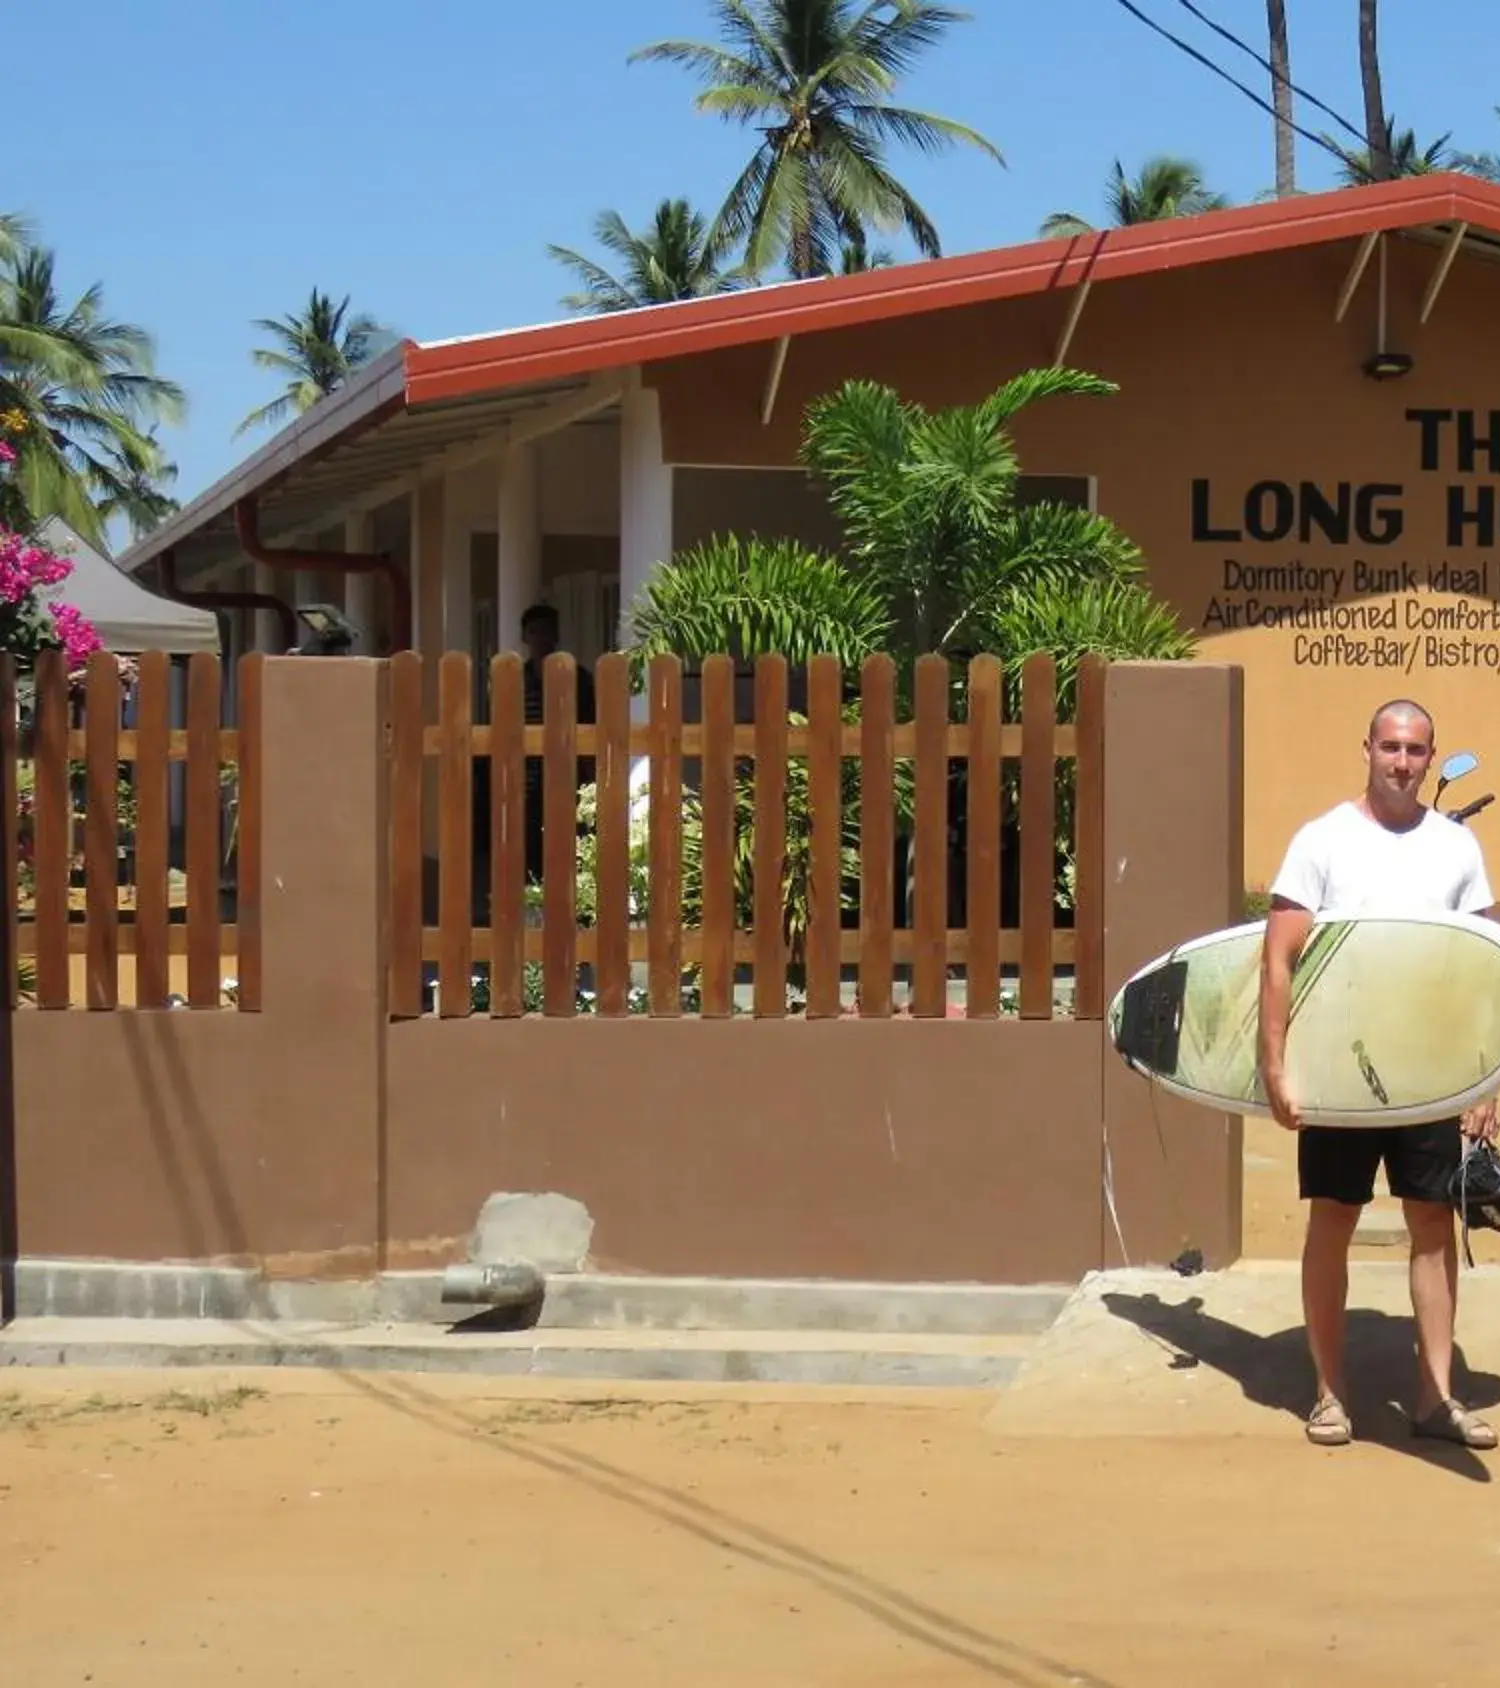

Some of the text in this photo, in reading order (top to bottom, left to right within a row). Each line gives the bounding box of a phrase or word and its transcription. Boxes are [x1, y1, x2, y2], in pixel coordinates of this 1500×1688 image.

[1192, 478, 1403, 545] LONG
[1222, 559, 1345, 597] Dormitory
[1353, 560, 1418, 593] Bunk
[1405, 598, 1500, 631] Comfort
